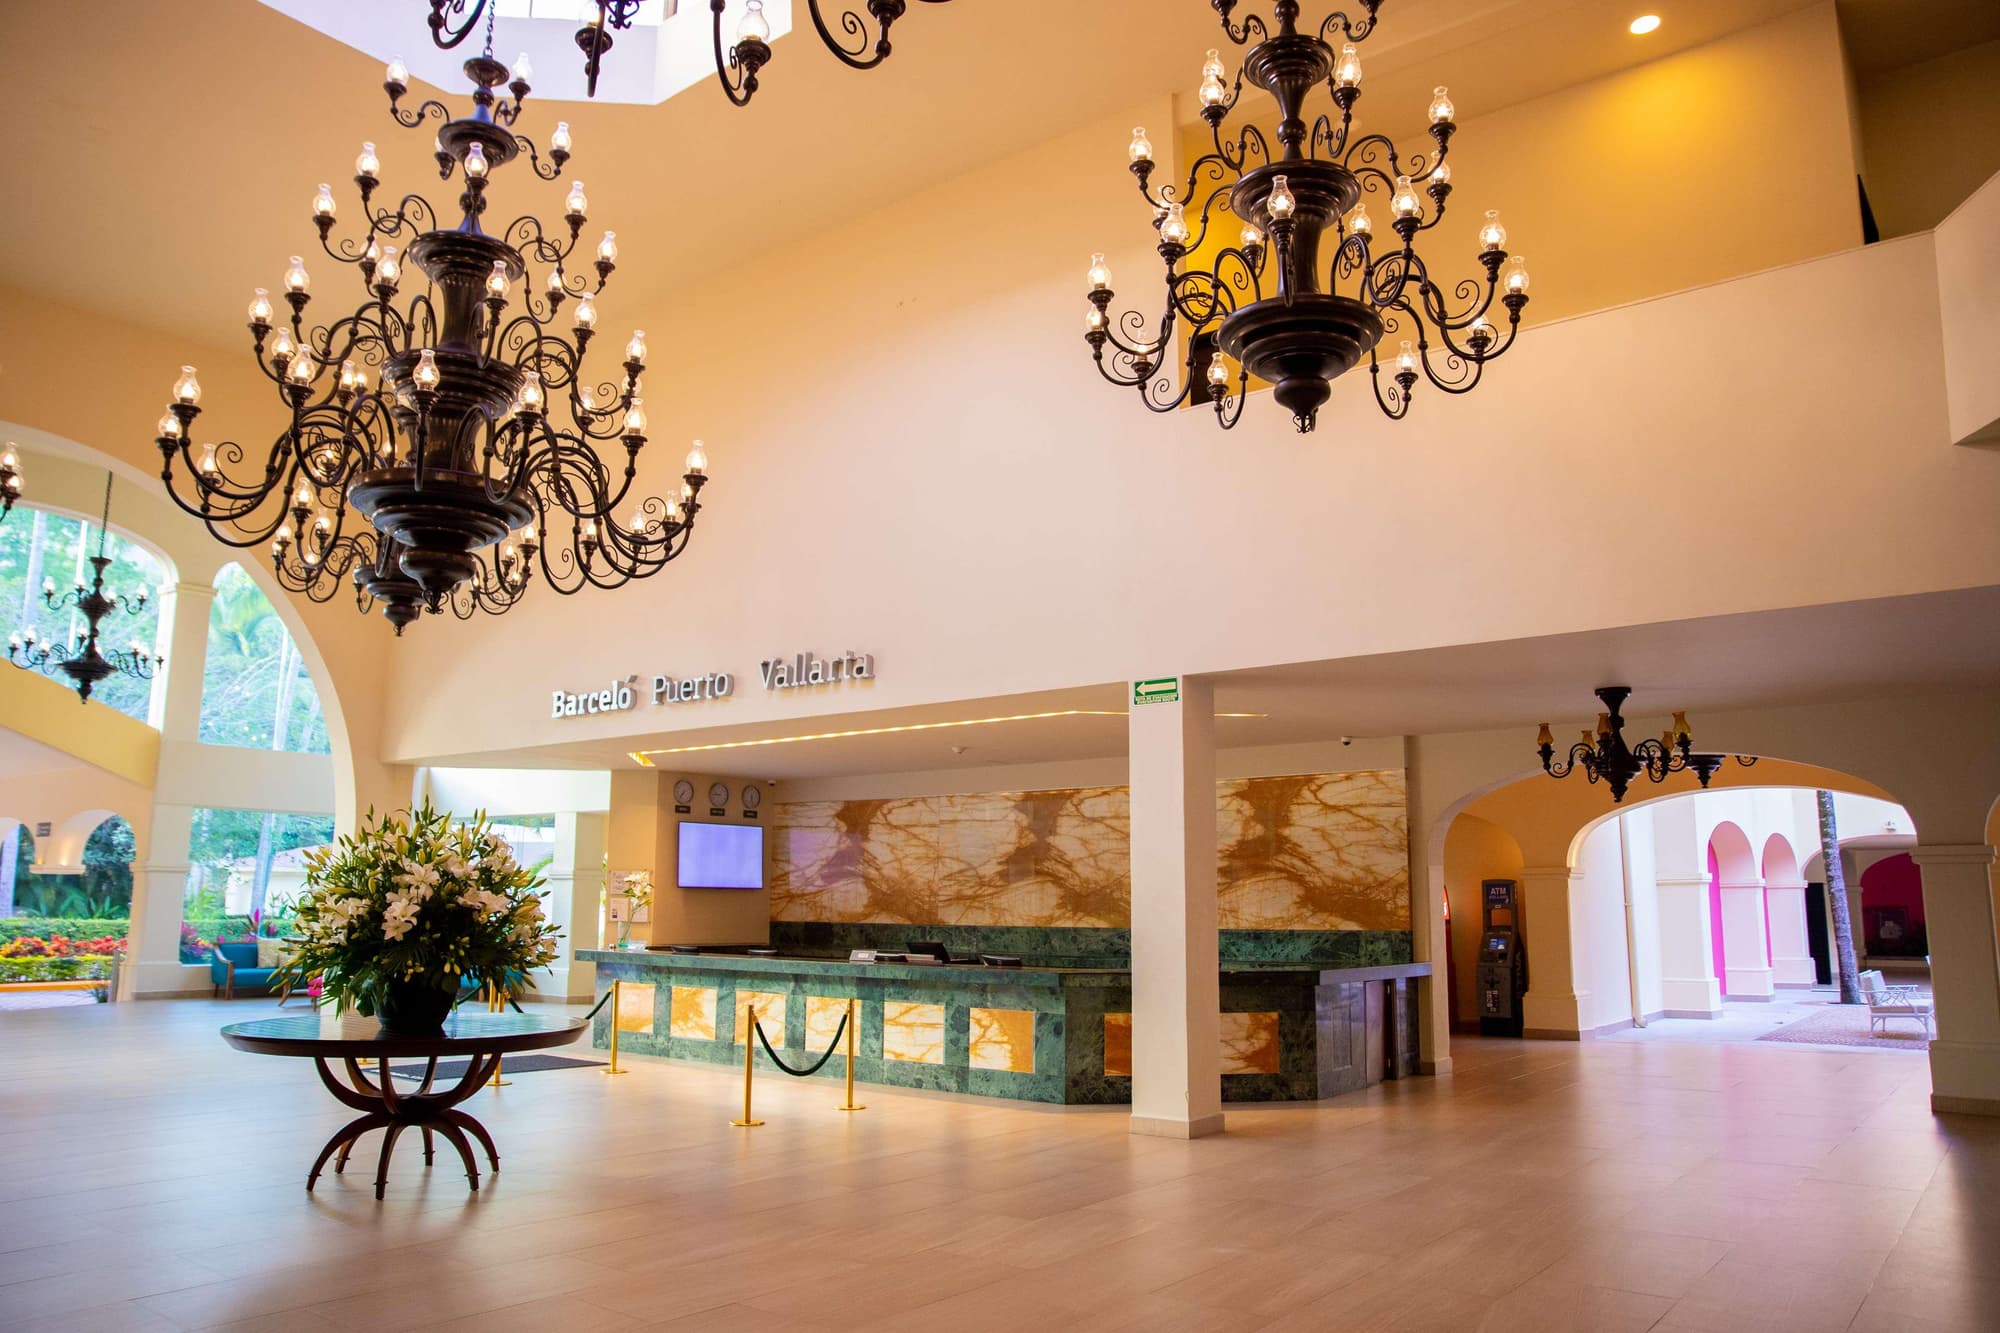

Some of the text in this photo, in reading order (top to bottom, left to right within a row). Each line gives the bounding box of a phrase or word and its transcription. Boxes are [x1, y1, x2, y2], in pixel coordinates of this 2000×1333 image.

[552, 650, 874, 718] Barceló Puerto Vallarta
[1490, 887, 1506, 895] ATM
